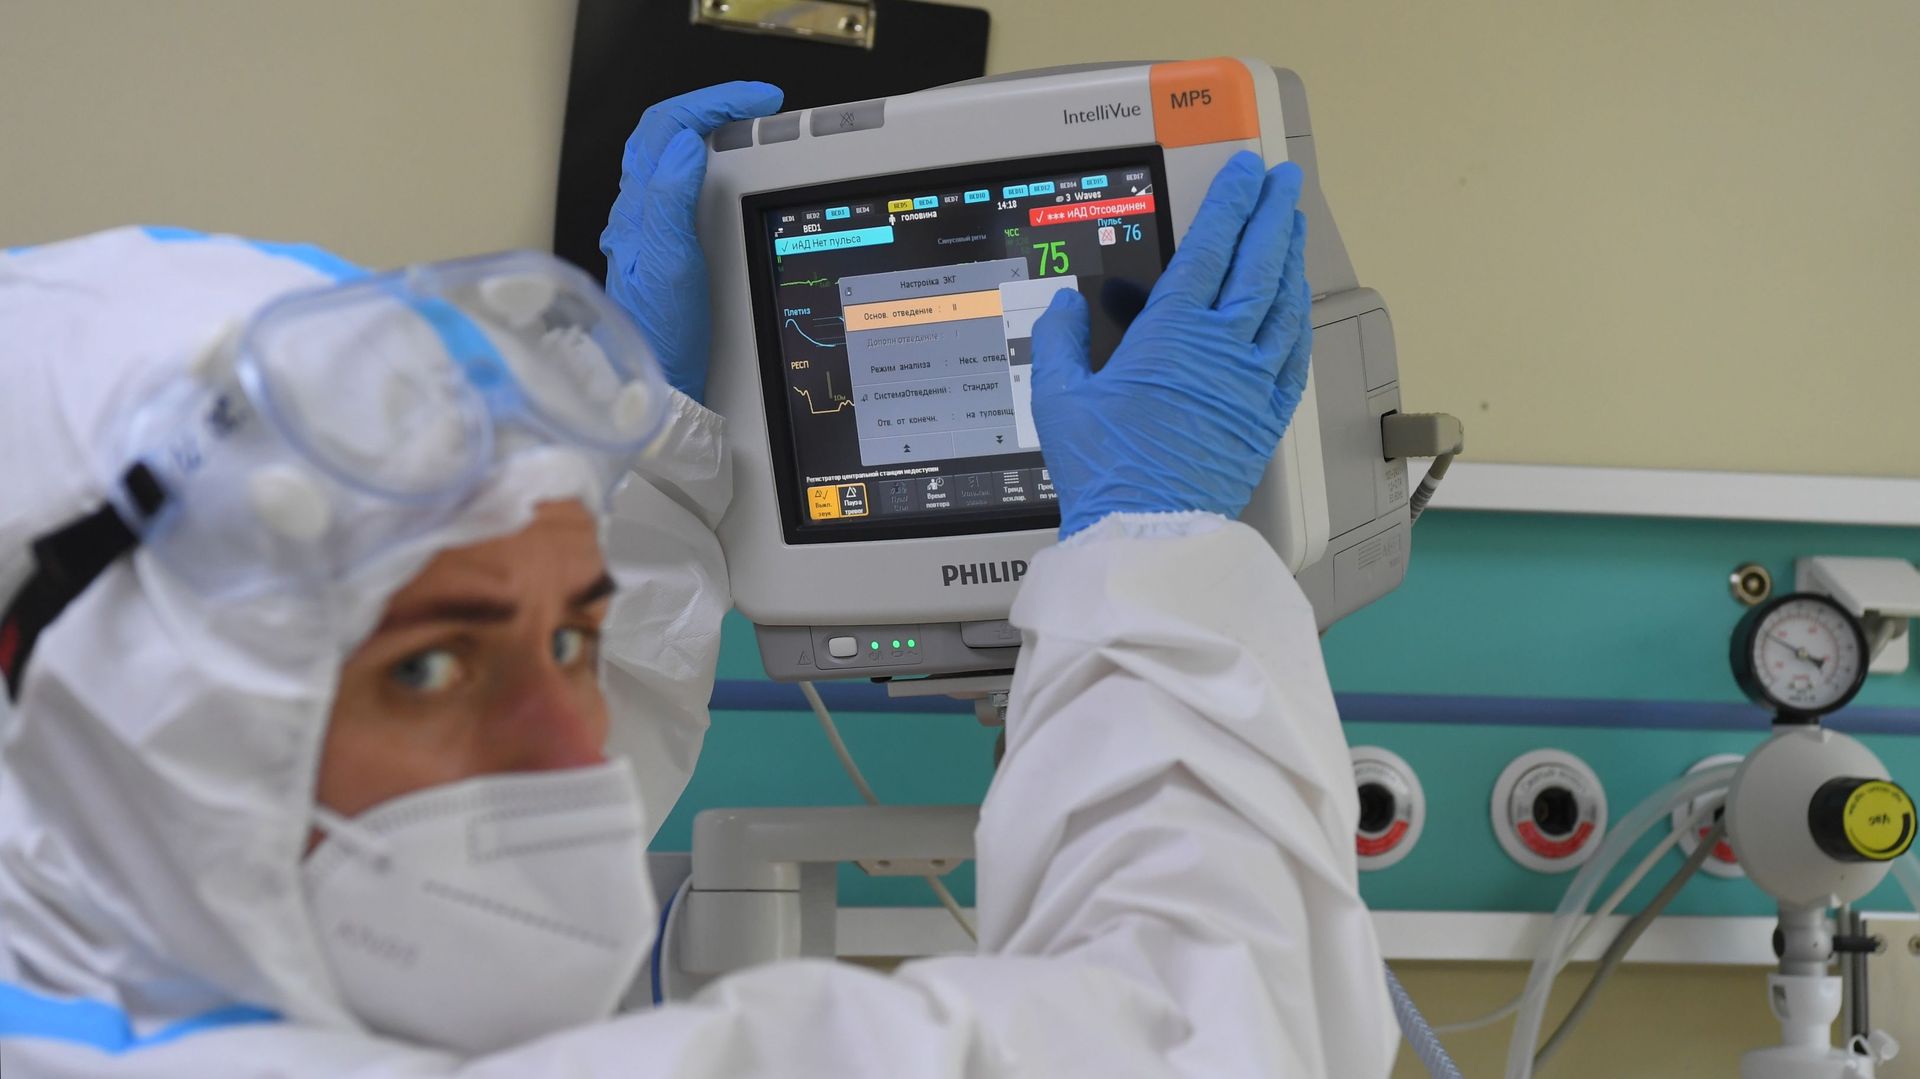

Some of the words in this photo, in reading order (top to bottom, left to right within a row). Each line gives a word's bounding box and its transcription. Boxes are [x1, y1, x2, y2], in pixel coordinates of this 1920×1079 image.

[1170, 88, 1212, 110] MP5
[1063, 102, 1142, 124] IntelliVue
[1066, 193, 1071, 202] 3
[1074, 190, 1102, 200] Waves
[997, 200, 1017, 210] 14:18
[1067, 206, 1088, 218] иАД
[1089, 202, 1146, 216] Отсоединен
[901, 210, 937, 222] головина
[1097, 217, 1122, 227] Пульс
[802, 223, 822, 233] BED1
[1004, 228, 1020, 237] ЧСС
[1122, 224, 1142, 242] 76
[792, 240, 811, 250] иАД
[813, 238, 827, 248] Нет
[829, 235, 862, 246] пульса
[1032, 240, 1070, 276] 75
[943, 275, 956, 284] ЭКГ
[784, 308, 811, 317] Плетиз
[892, 307, 933, 317] отведение
[791, 360, 810, 370] РЕСП
[870, 365, 896, 373] Режим
[900, 361, 931, 370] анализа
[962, 381, 998, 392] Стандарт
[941, 560, 1031, 586] PHILIP
